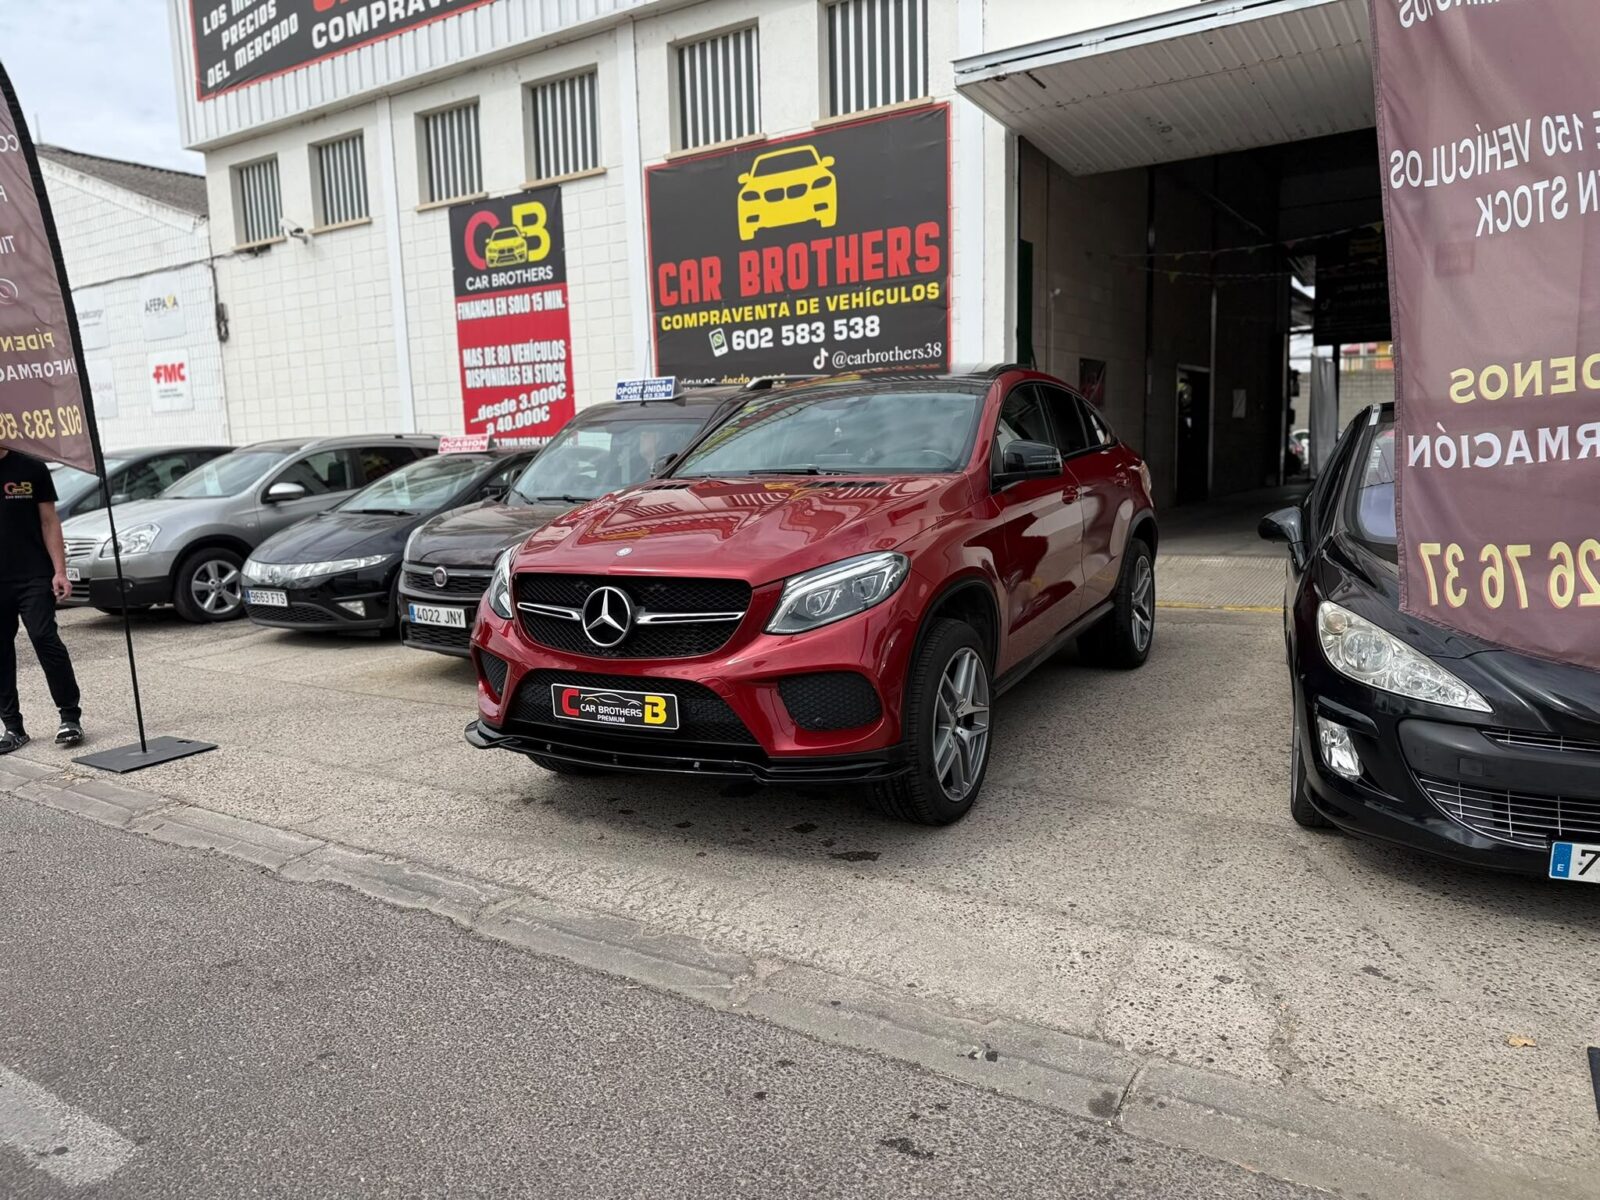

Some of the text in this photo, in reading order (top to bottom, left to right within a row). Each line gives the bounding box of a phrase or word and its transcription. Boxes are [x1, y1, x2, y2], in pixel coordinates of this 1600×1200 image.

[203, 3, 227, 36] LOS
[221, 0, 277, 51] PRECIOS
[311, 0, 451, 49] COMPRA
[207, 12, 299, 89] DEL MERCADO
[465, 265, 554, 291] CAR BROTHERS
[658, 221, 941, 307] CAR BROTHERS
[495, 296, 508, 316] EN
[508, 293, 531, 315] SOLO
[531, 292, 544, 312] 15
[661, 282, 941, 332] COMPRAVENTA DE VEHÍCULOS
[732, 315, 881, 351] 602 583 538
[462, 347, 484, 369] MAS
[484, 345, 497, 366] DE
[510, 338, 567, 364] VEHÍCULOS
[832, 341, 943, 369] @carbrothers38
[153, 362, 186, 384] FMC
[465, 361, 567, 389] DISPONIBLES EN STOCK
[518, 382, 567, 410] 3.000€
[486, 404, 551, 435] a 40.000€
[416, 608, 463, 625] 4022 JNY
[580, 703, 643, 718] CAR BROTHERS
[597, 714, 626, 723] PREMIUM
[1556, 863, 1566, 872] E
